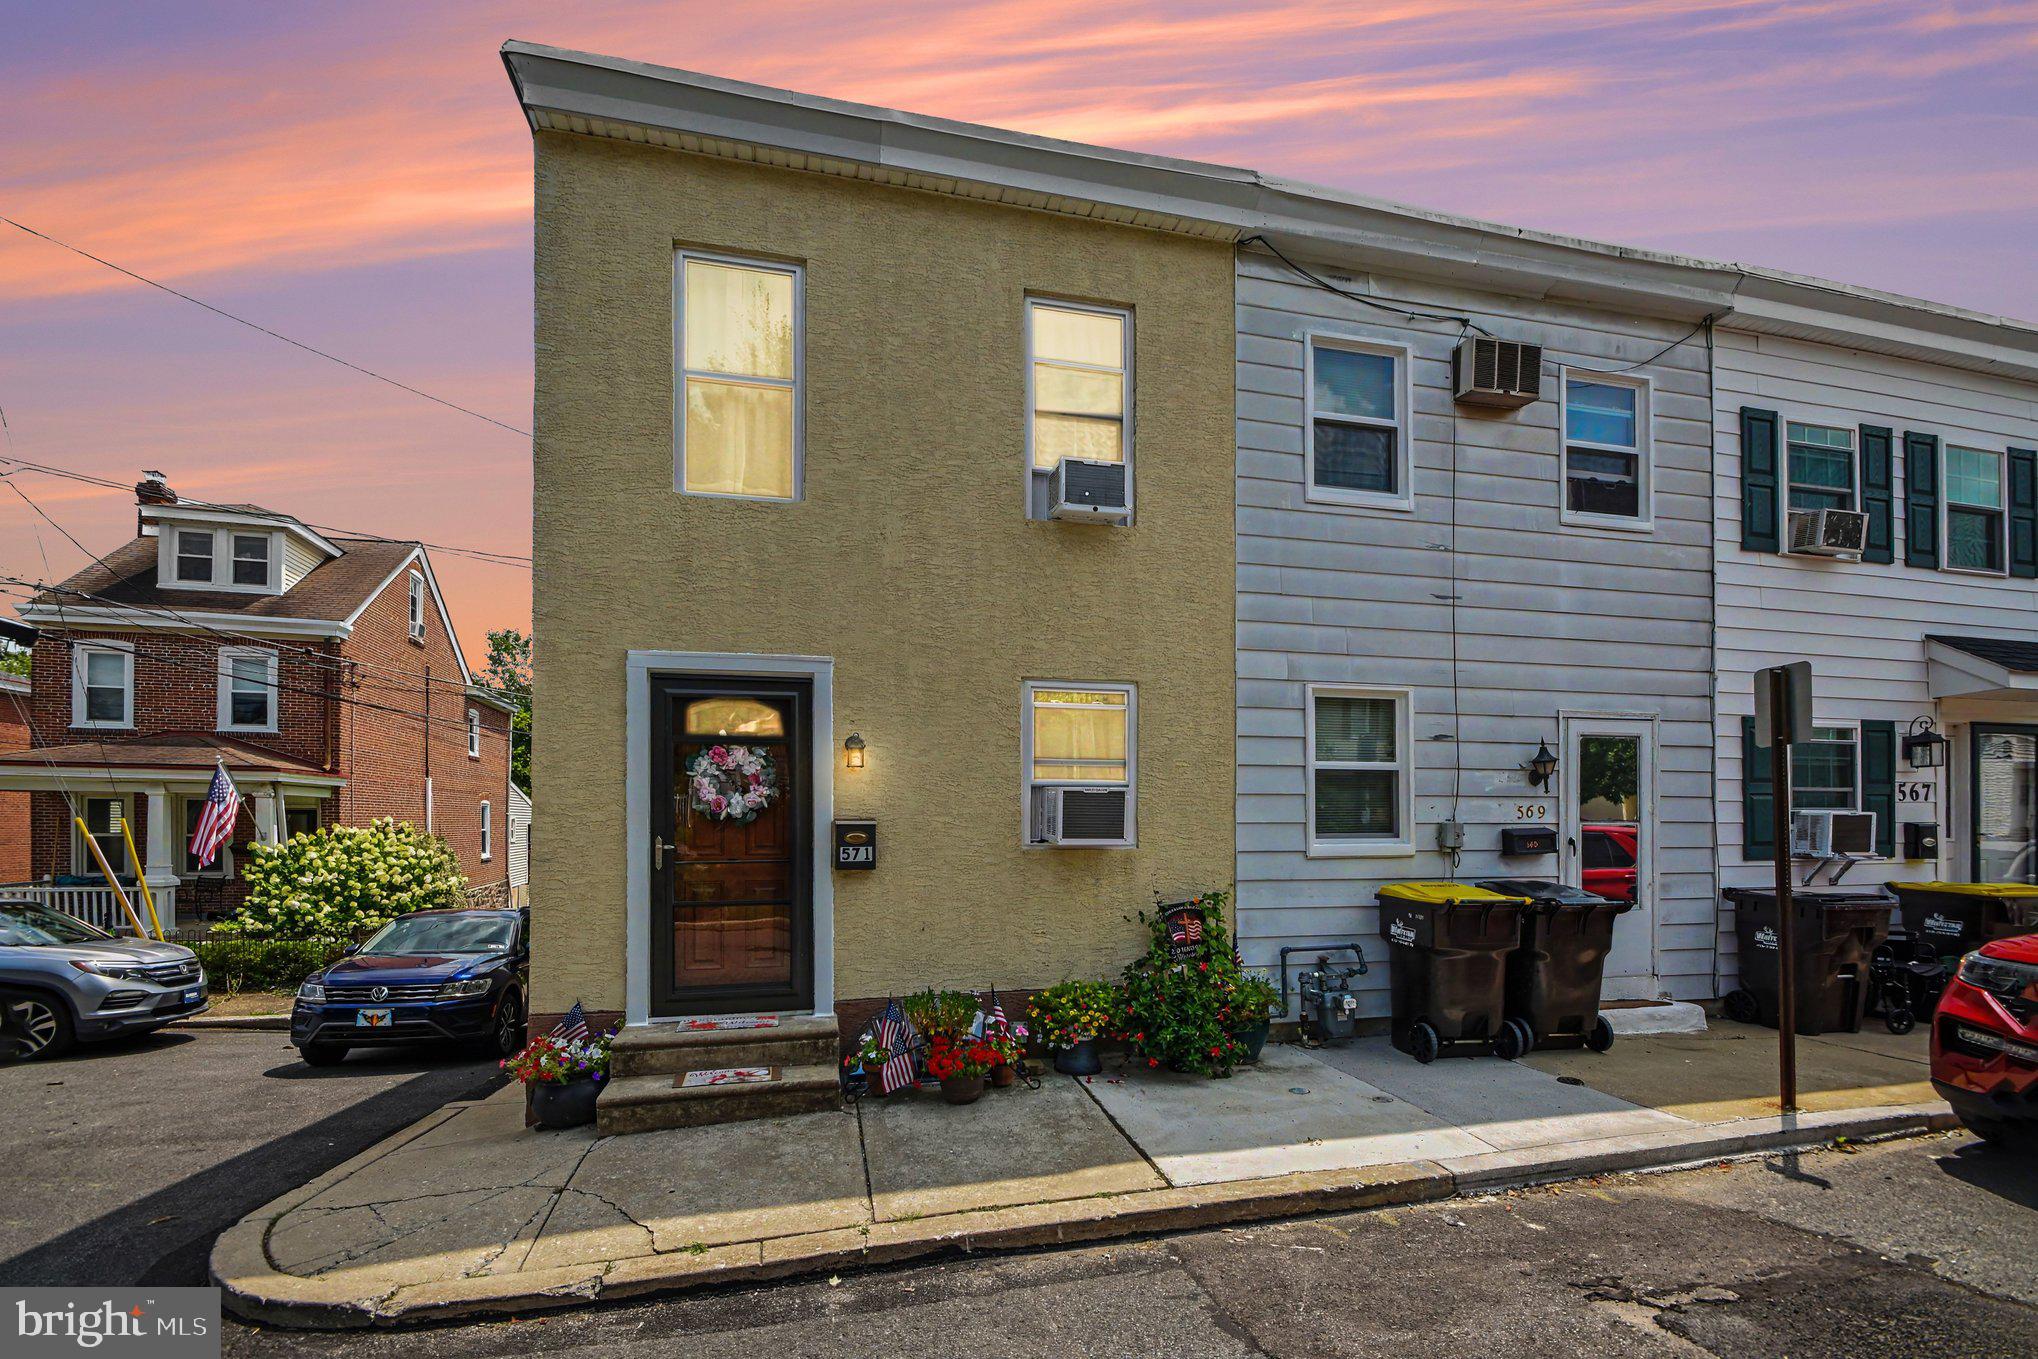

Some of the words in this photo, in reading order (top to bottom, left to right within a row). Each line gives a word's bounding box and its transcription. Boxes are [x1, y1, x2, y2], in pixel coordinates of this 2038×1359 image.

[1898, 782, 1931, 802] 567
[1517, 805, 1546, 819] 569
[841, 847, 871, 861] 571
